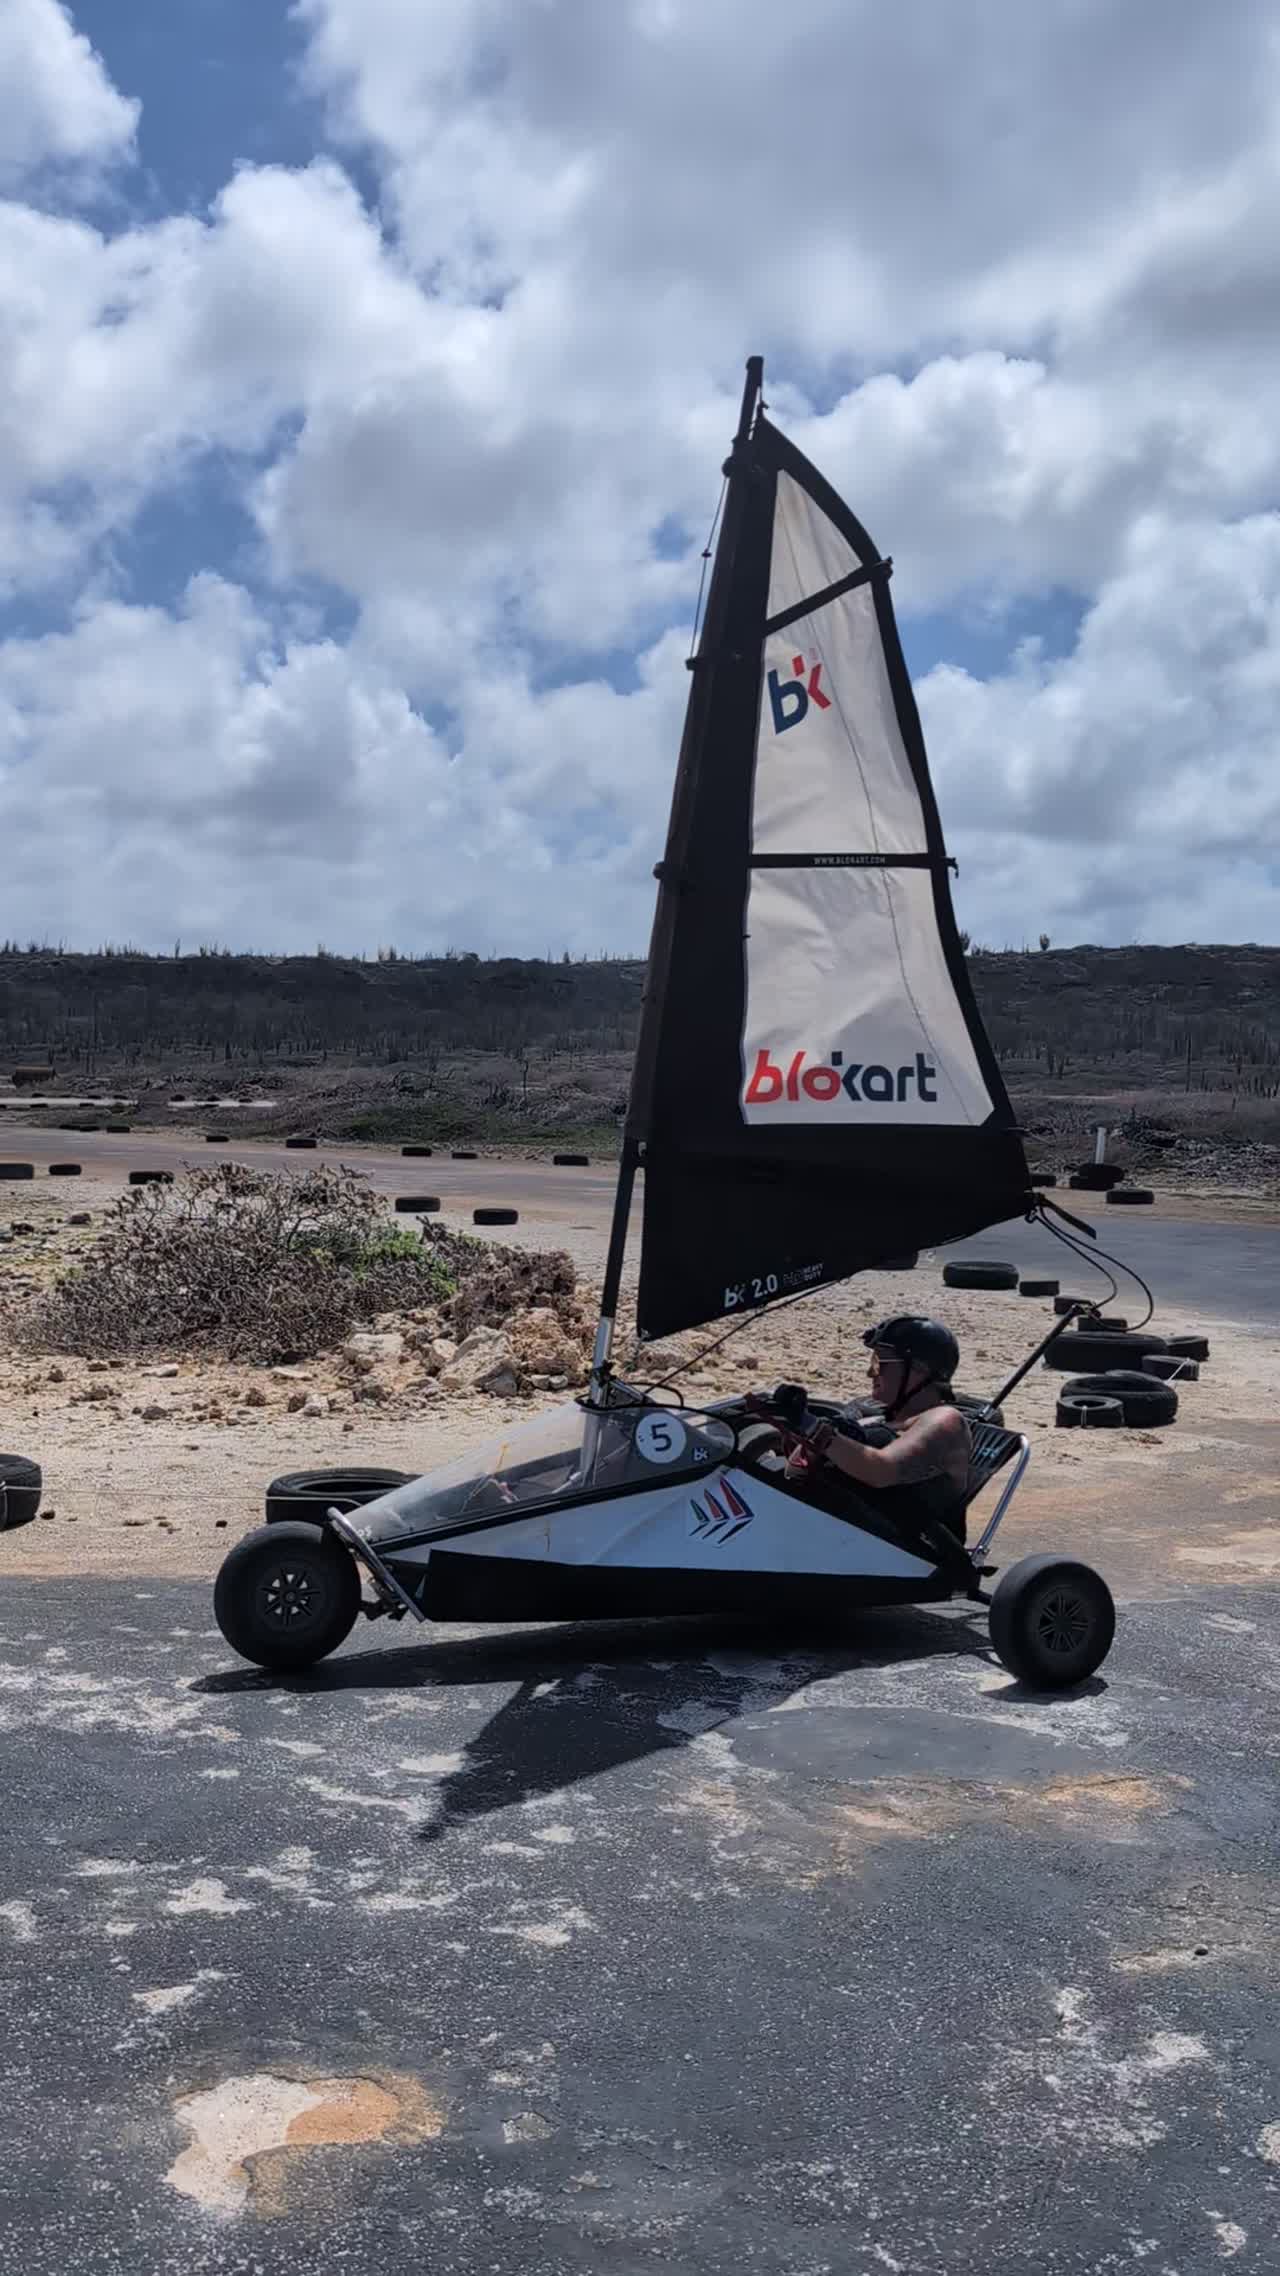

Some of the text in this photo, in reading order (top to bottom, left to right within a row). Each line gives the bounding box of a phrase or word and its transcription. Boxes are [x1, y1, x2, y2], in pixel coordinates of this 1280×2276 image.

[745, 1049, 936, 1104] blokart
[752, 1274, 778, 1298] 2.0
[651, 1423, 672, 1452] 5
